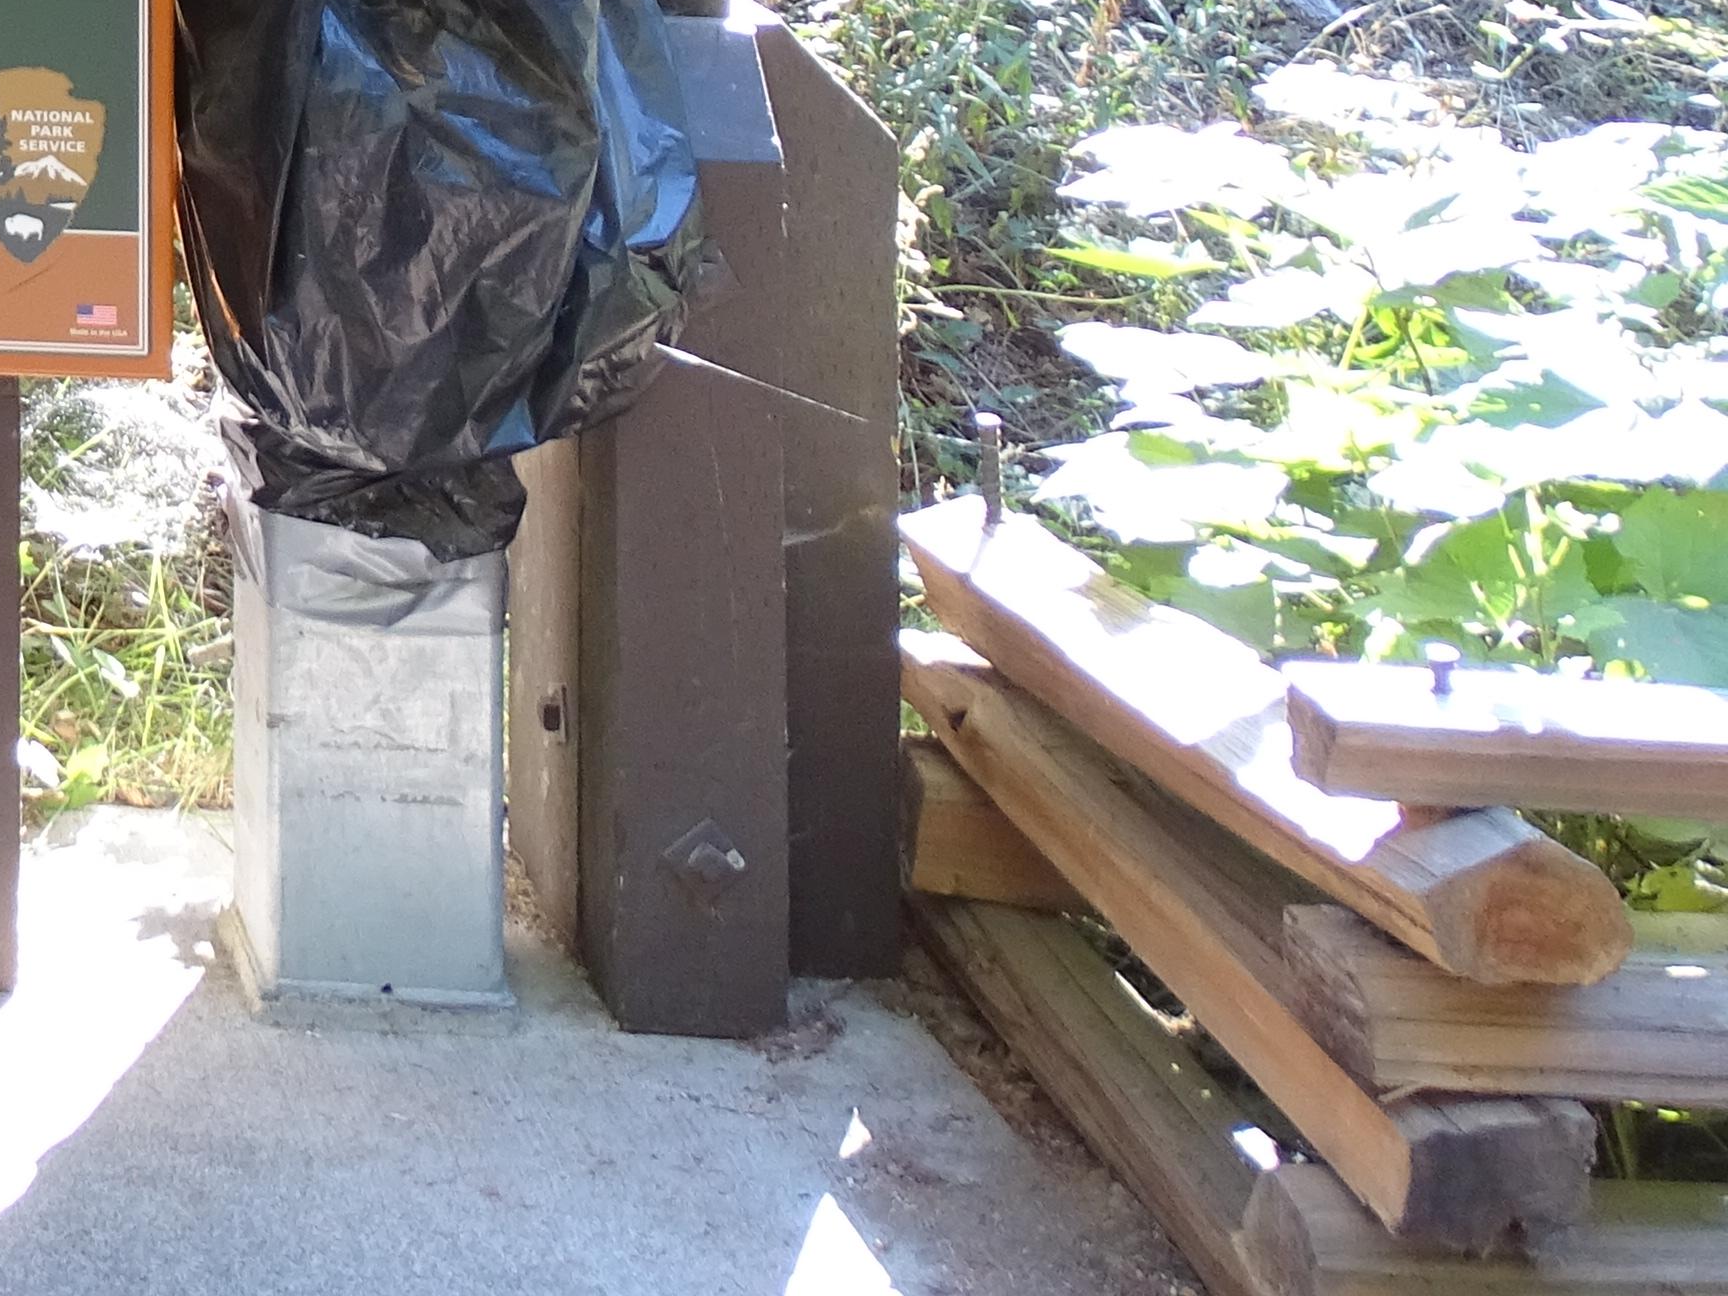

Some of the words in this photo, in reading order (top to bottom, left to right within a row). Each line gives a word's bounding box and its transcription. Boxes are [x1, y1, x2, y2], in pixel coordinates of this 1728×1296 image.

[12, 110, 94, 124] NATIONAL
[31, 125, 73, 137] PARK
[20, 140, 85, 153] SERVICE
